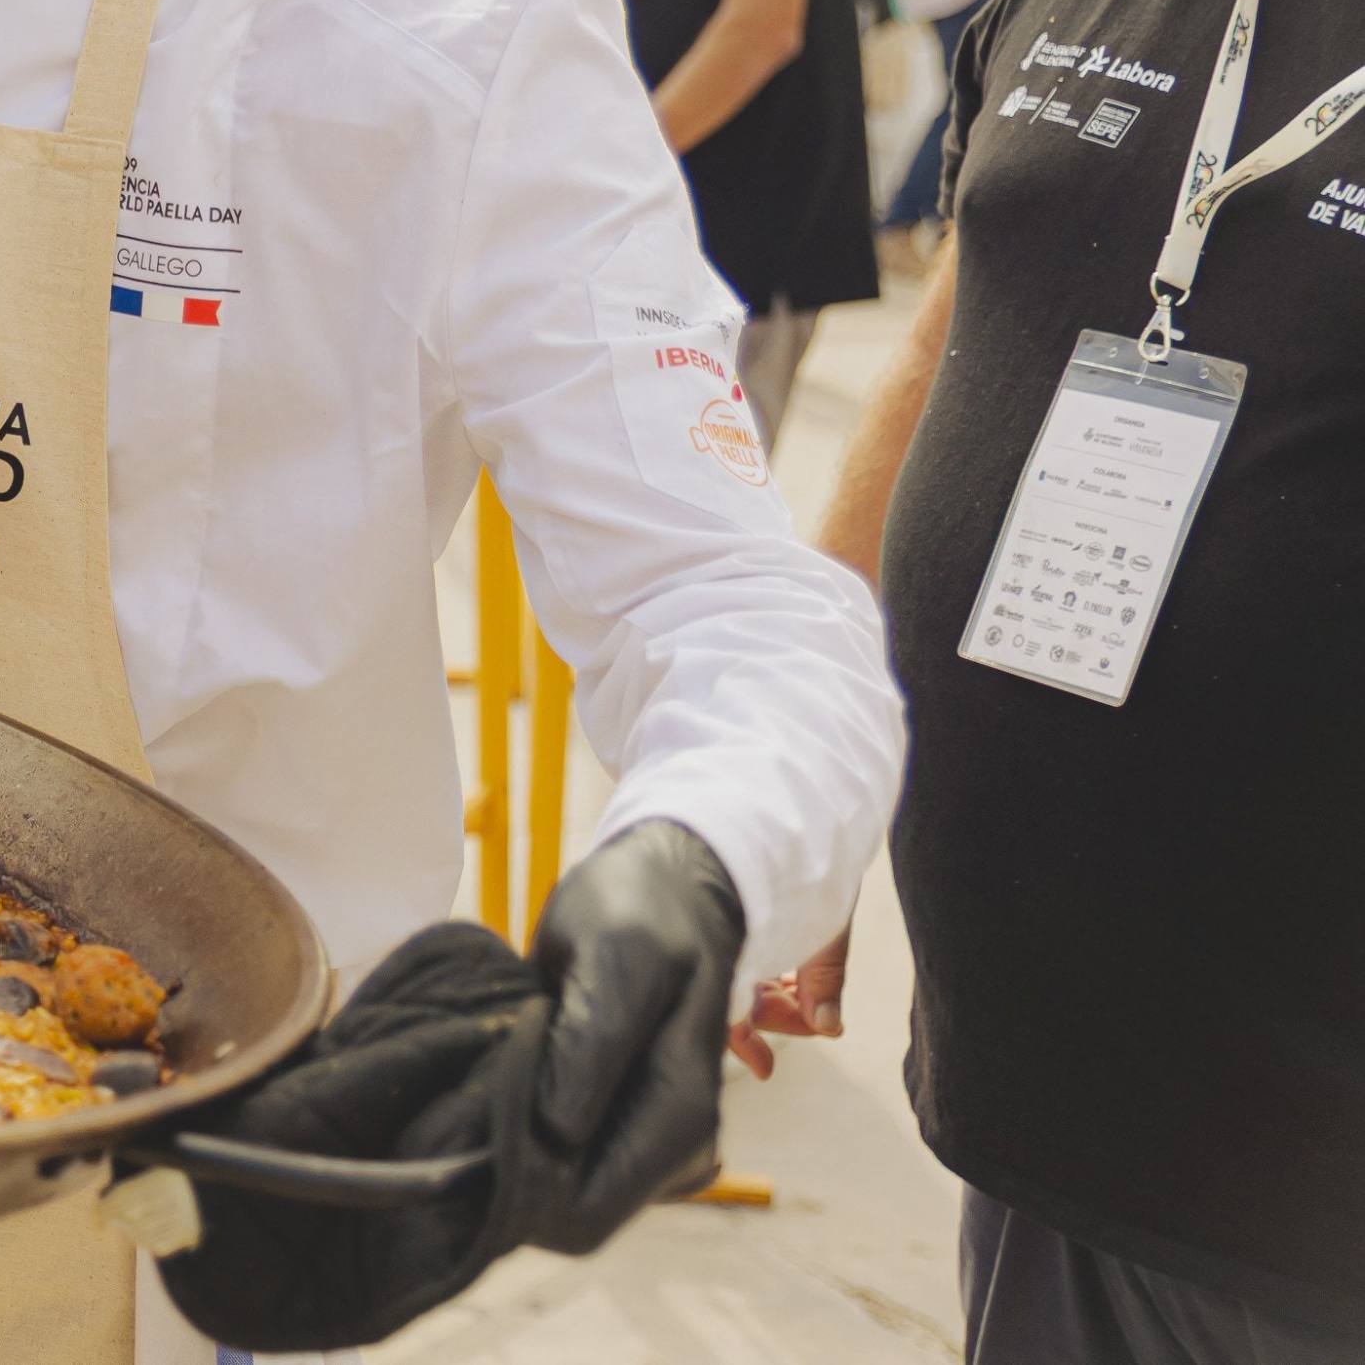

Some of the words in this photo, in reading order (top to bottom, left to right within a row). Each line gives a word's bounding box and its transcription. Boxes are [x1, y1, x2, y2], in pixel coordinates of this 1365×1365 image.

[1105, 57, 1176, 93] Labora
[1087, 120, 1123, 142] SEPE
[147, 199, 203, 222] PAELLA
[209, 207, 242, 225] DAY
[1307, 200, 1340, 225] DE
[117, 248, 202, 277] GALLEGO
[655, 347, 727, 383] IBERIA
